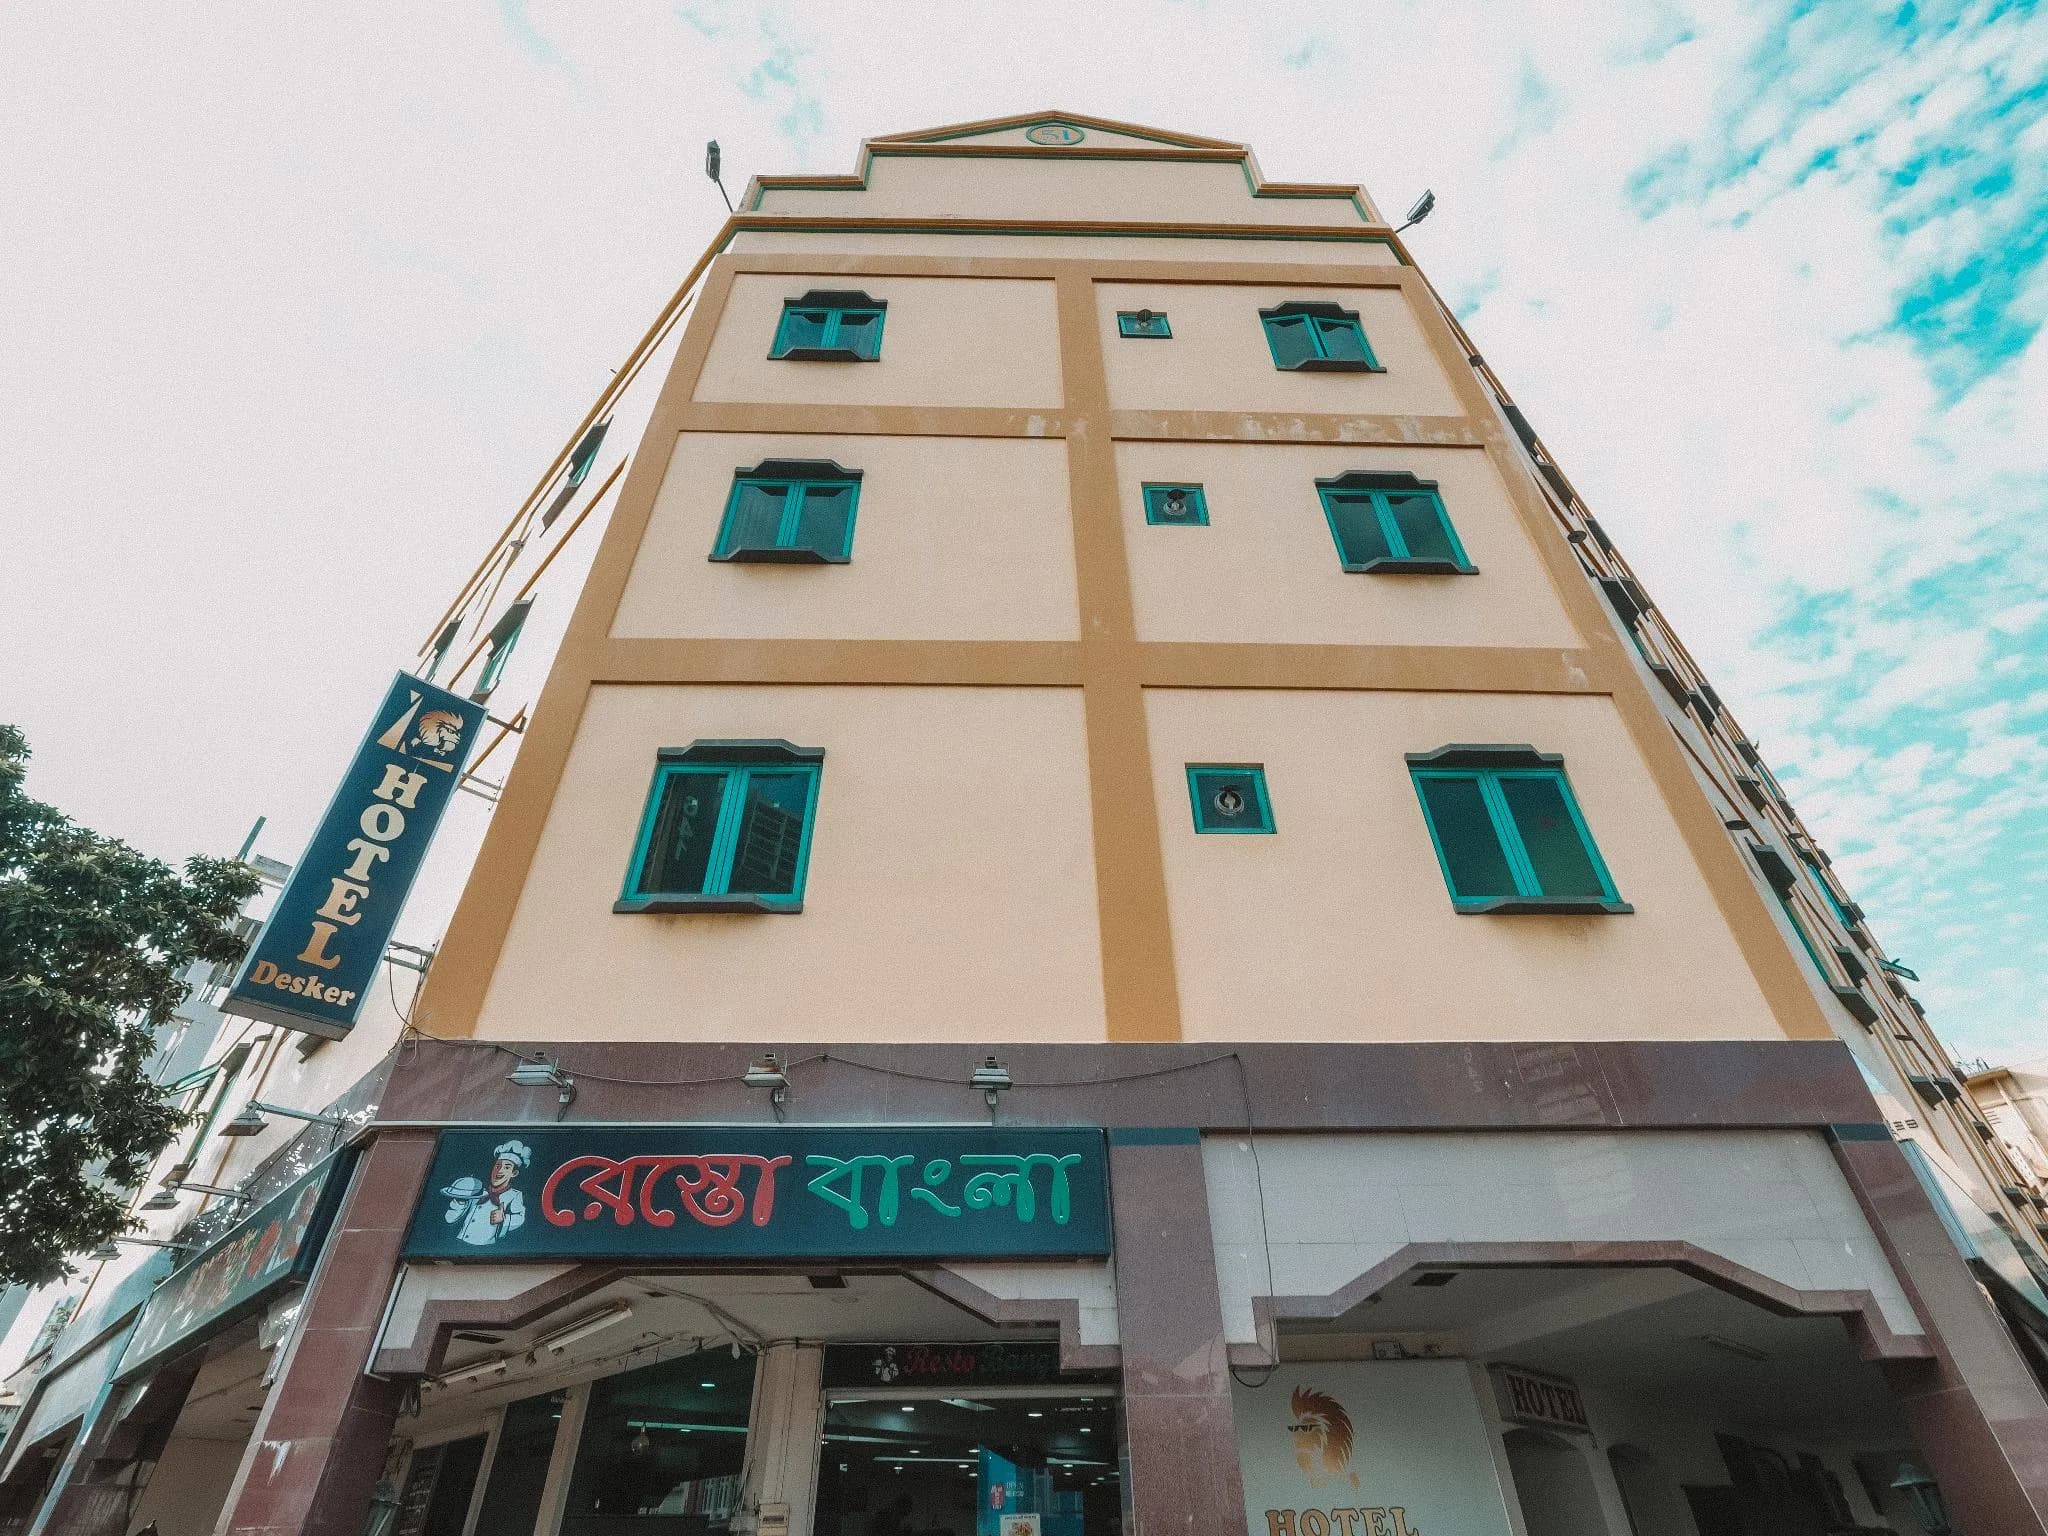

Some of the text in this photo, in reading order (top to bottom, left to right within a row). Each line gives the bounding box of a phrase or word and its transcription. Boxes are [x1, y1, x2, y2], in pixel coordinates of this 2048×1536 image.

[296, 762, 428, 971] HOTEL
[248, 959, 356, 1009] Desker
[541, 1153, 1082, 1229] রেস্তো বাংলা
[1505, 1374, 1589, 1426] HOTEL
[1264, 1506, 1419, 1536] HOTEL
